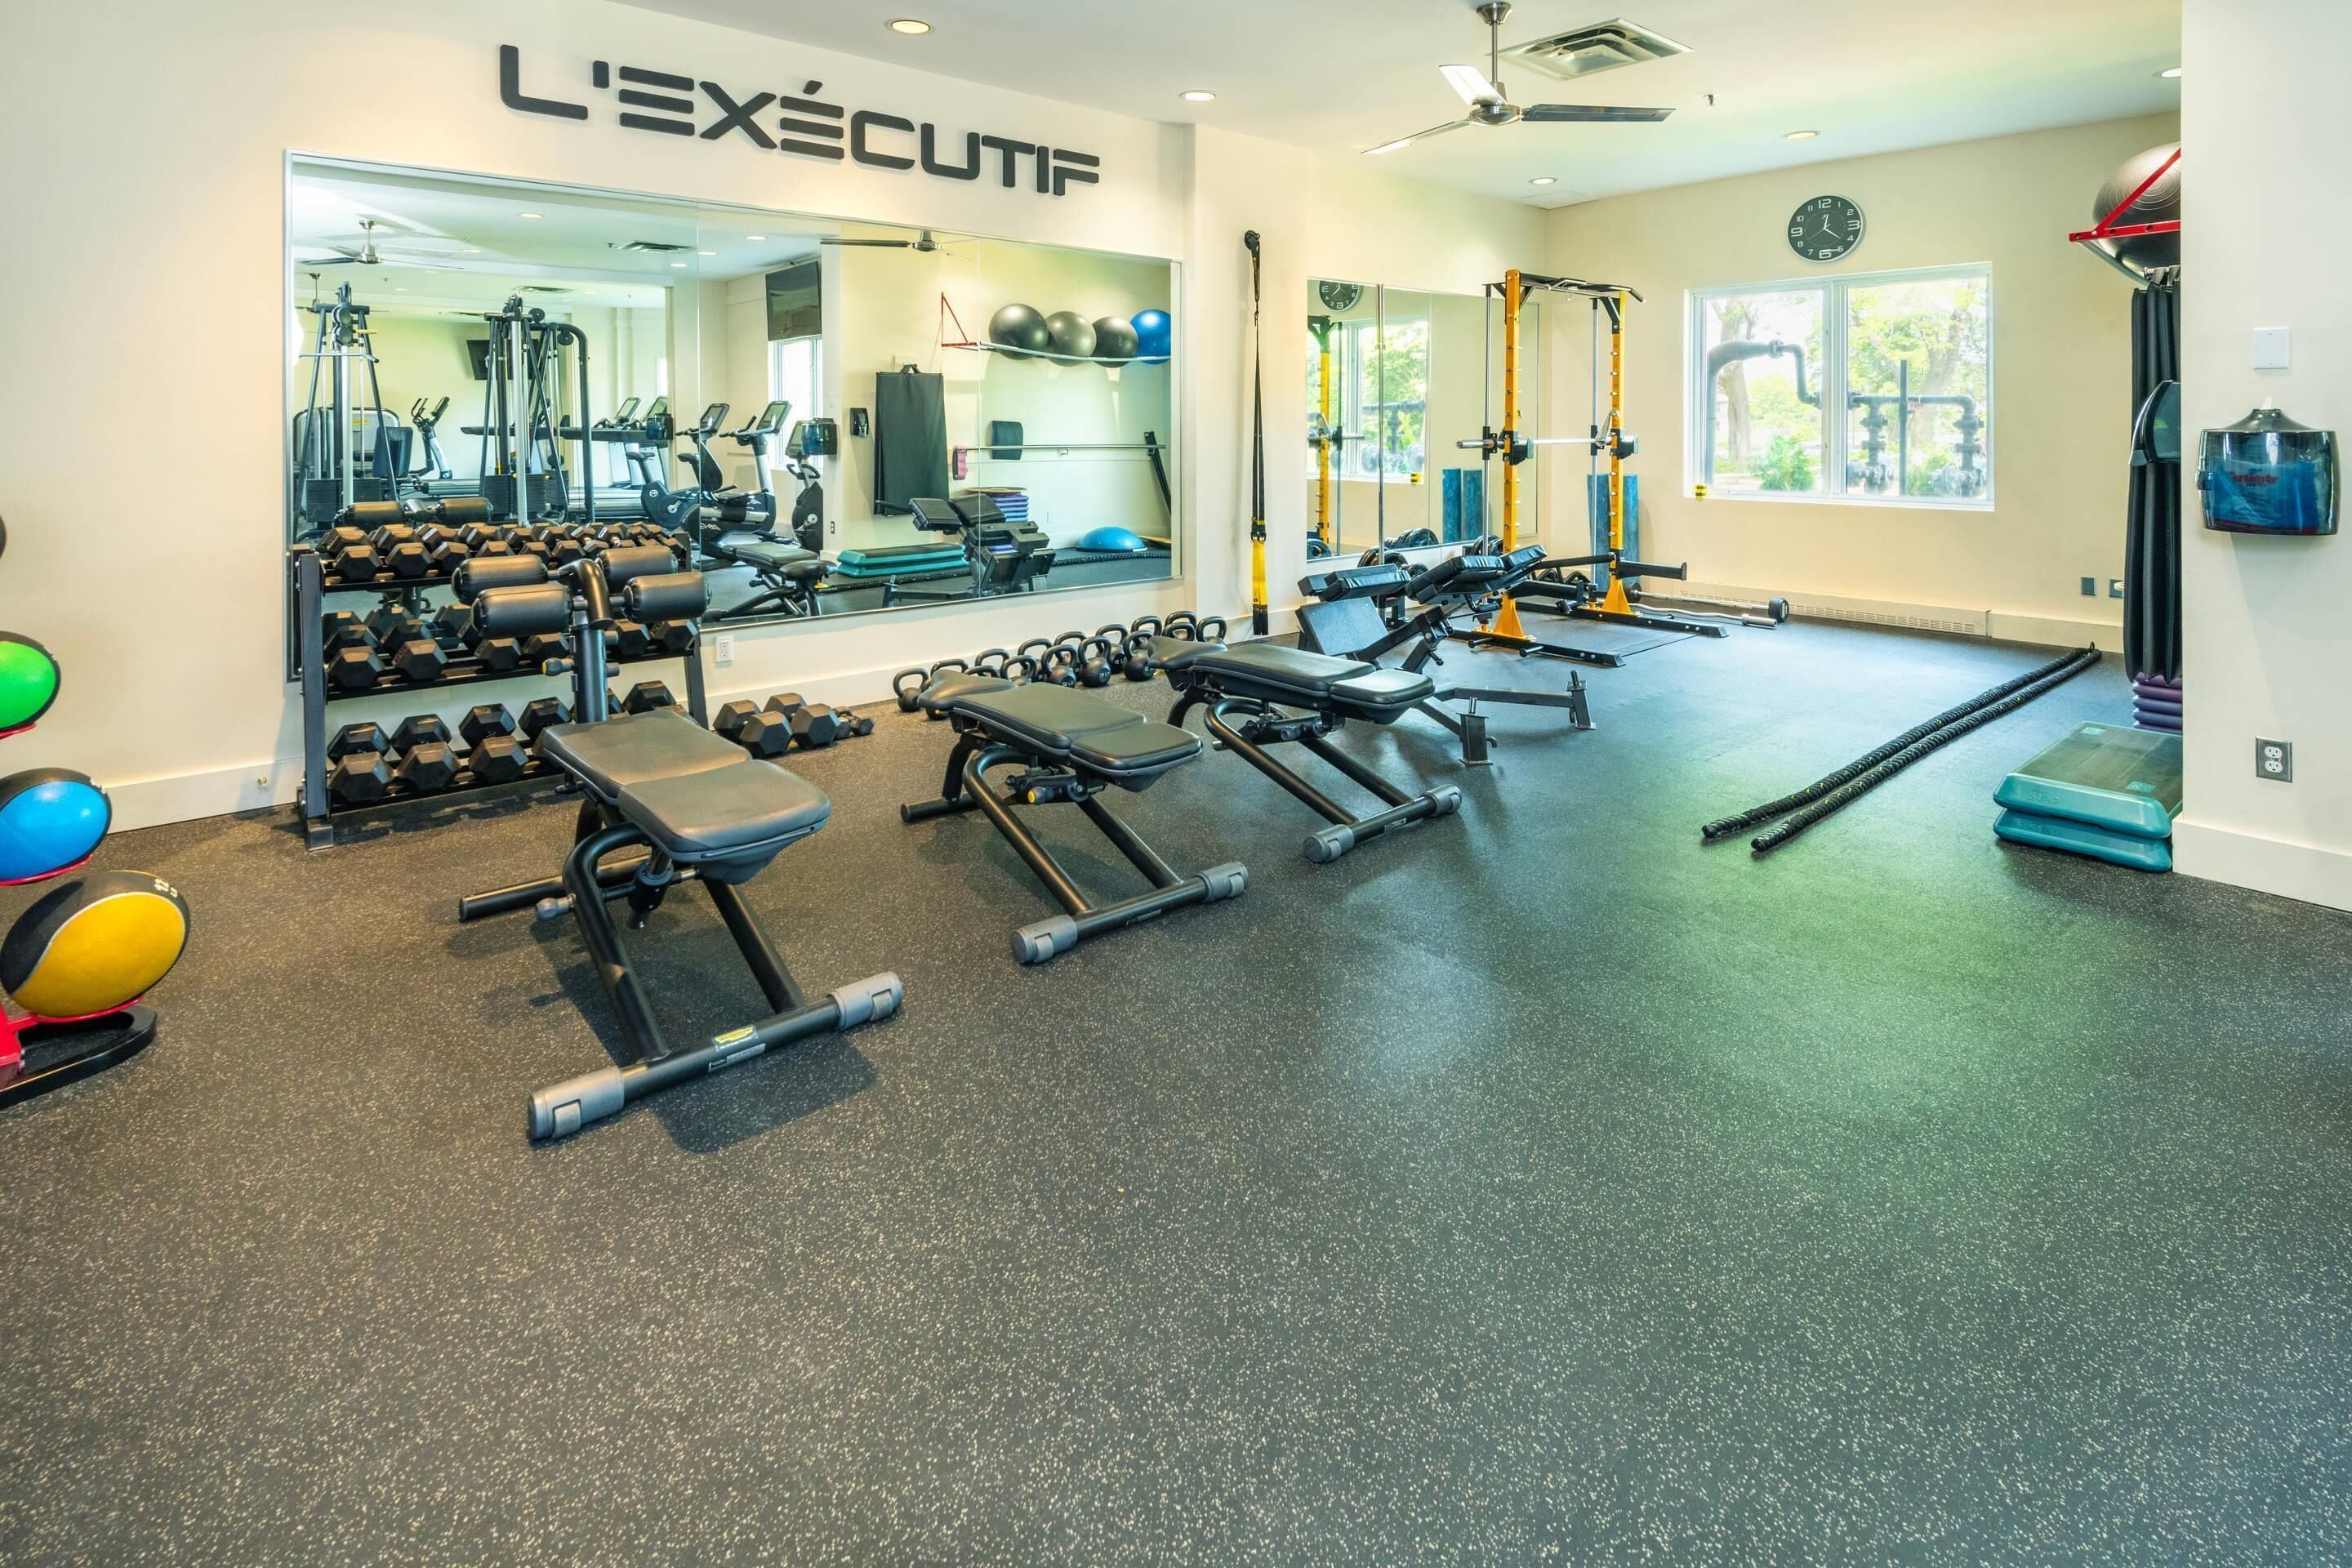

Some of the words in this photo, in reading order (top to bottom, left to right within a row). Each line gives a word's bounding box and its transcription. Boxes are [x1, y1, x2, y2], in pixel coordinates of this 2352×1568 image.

[500, 44, 1100, 196] L'EXÉCUTIF
[1817, 198, 1831, 209] 12
[1846, 220, 1860, 230] 3
[1790, 227, 1803, 237] 9
[1819, 249, 1832, 259] 6
